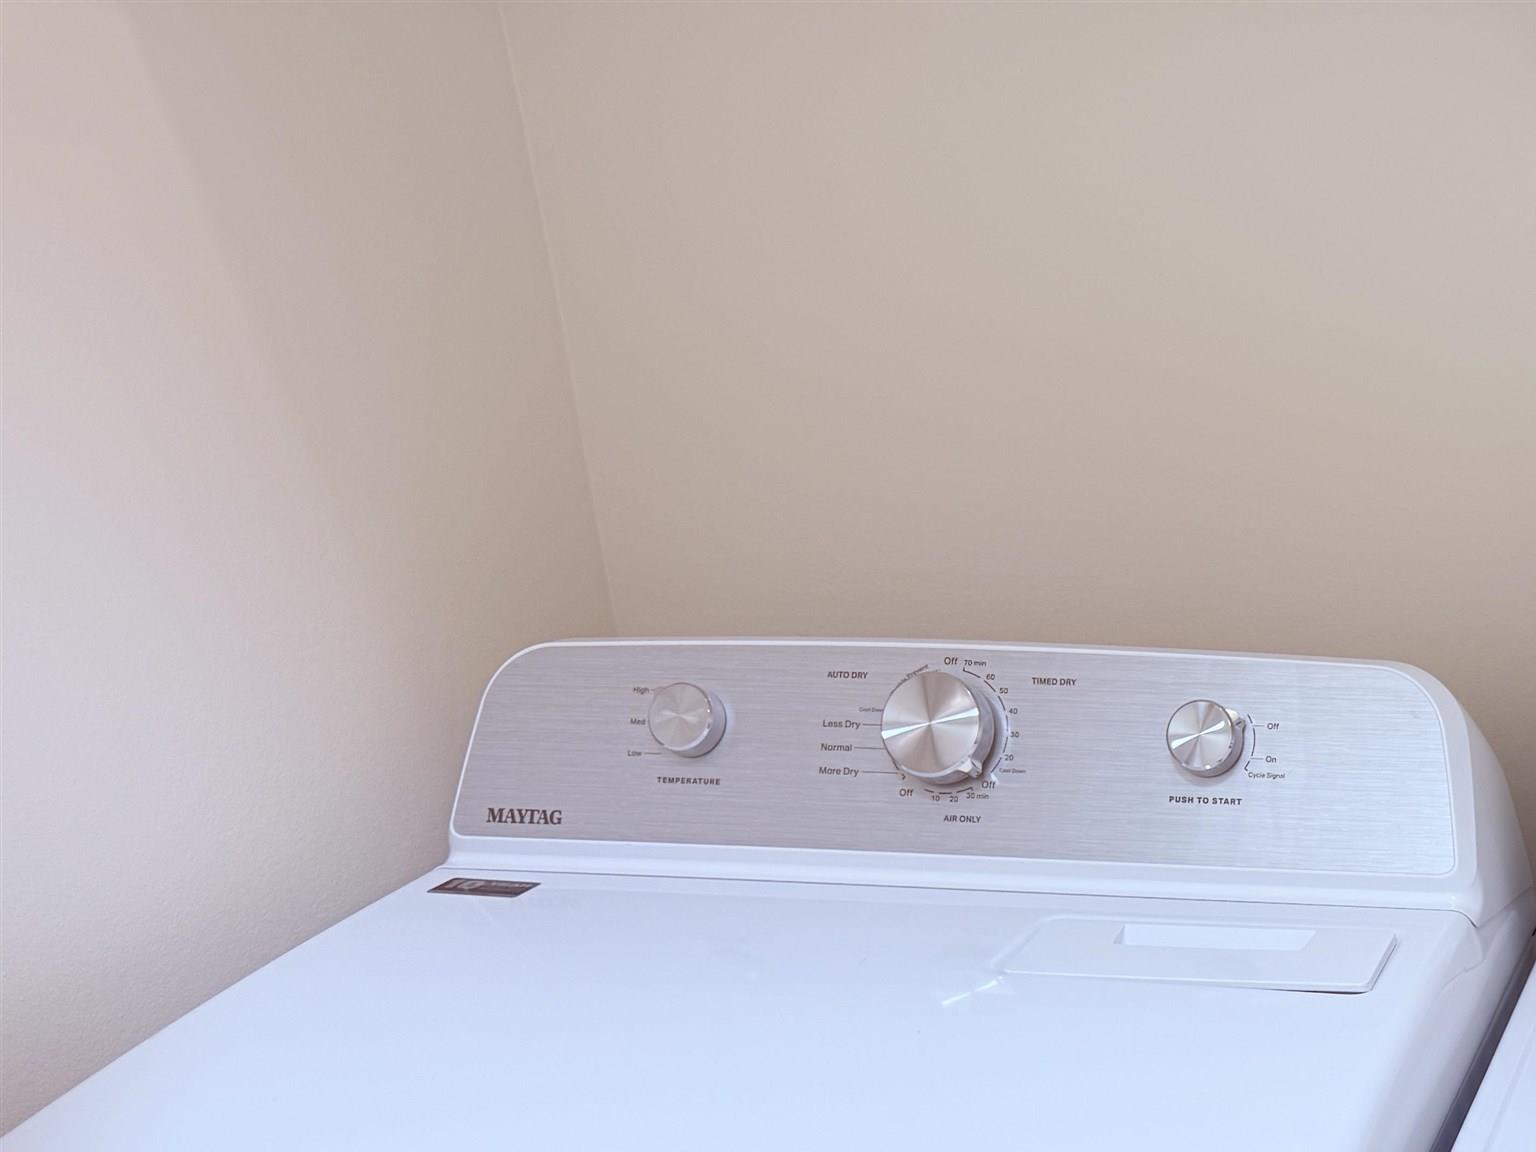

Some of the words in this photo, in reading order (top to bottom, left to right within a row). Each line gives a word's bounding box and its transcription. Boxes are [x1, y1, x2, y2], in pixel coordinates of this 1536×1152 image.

[944, 656, 958, 665] Off
[964, 659, 973, 667] 70
[827, 671, 850, 679] AUTO
[851, 671, 868, 679] DRY
[986, 673, 996, 681] 60
[1032, 677, 1058, 686] TIMED
[1059, 678, 1077, 687] DRY
[633, 687, 650, 695] High
[822, 720, 842, 729] Less
[843, 720, 861, 730] Dry
[1266, 722, 1280, 730] Off
[820, 743, 853, 752] Normal
[1265, 755, 1277, 763] On
[818, 767, 843, 776] More
[844, 767, 860, 778] Dry
[1248, 772, 1266, 780] Cycle
[1266, 772, 1286, 780] Signal
[657, 776, 721, 786] TEMPERATURE
[981, 780, 996, 789] Off
[899, 788, 914, 797] Off
[1168, 795, 1194, 804] PUSH
[1197, 796, 1209, 805] TO
[1212, 797, 1243, 806] START
[485, 807, 563, 825] MAYTAG
[943, 815, 957, 824] AIR
[958, 815, 982, 824] ONLY
